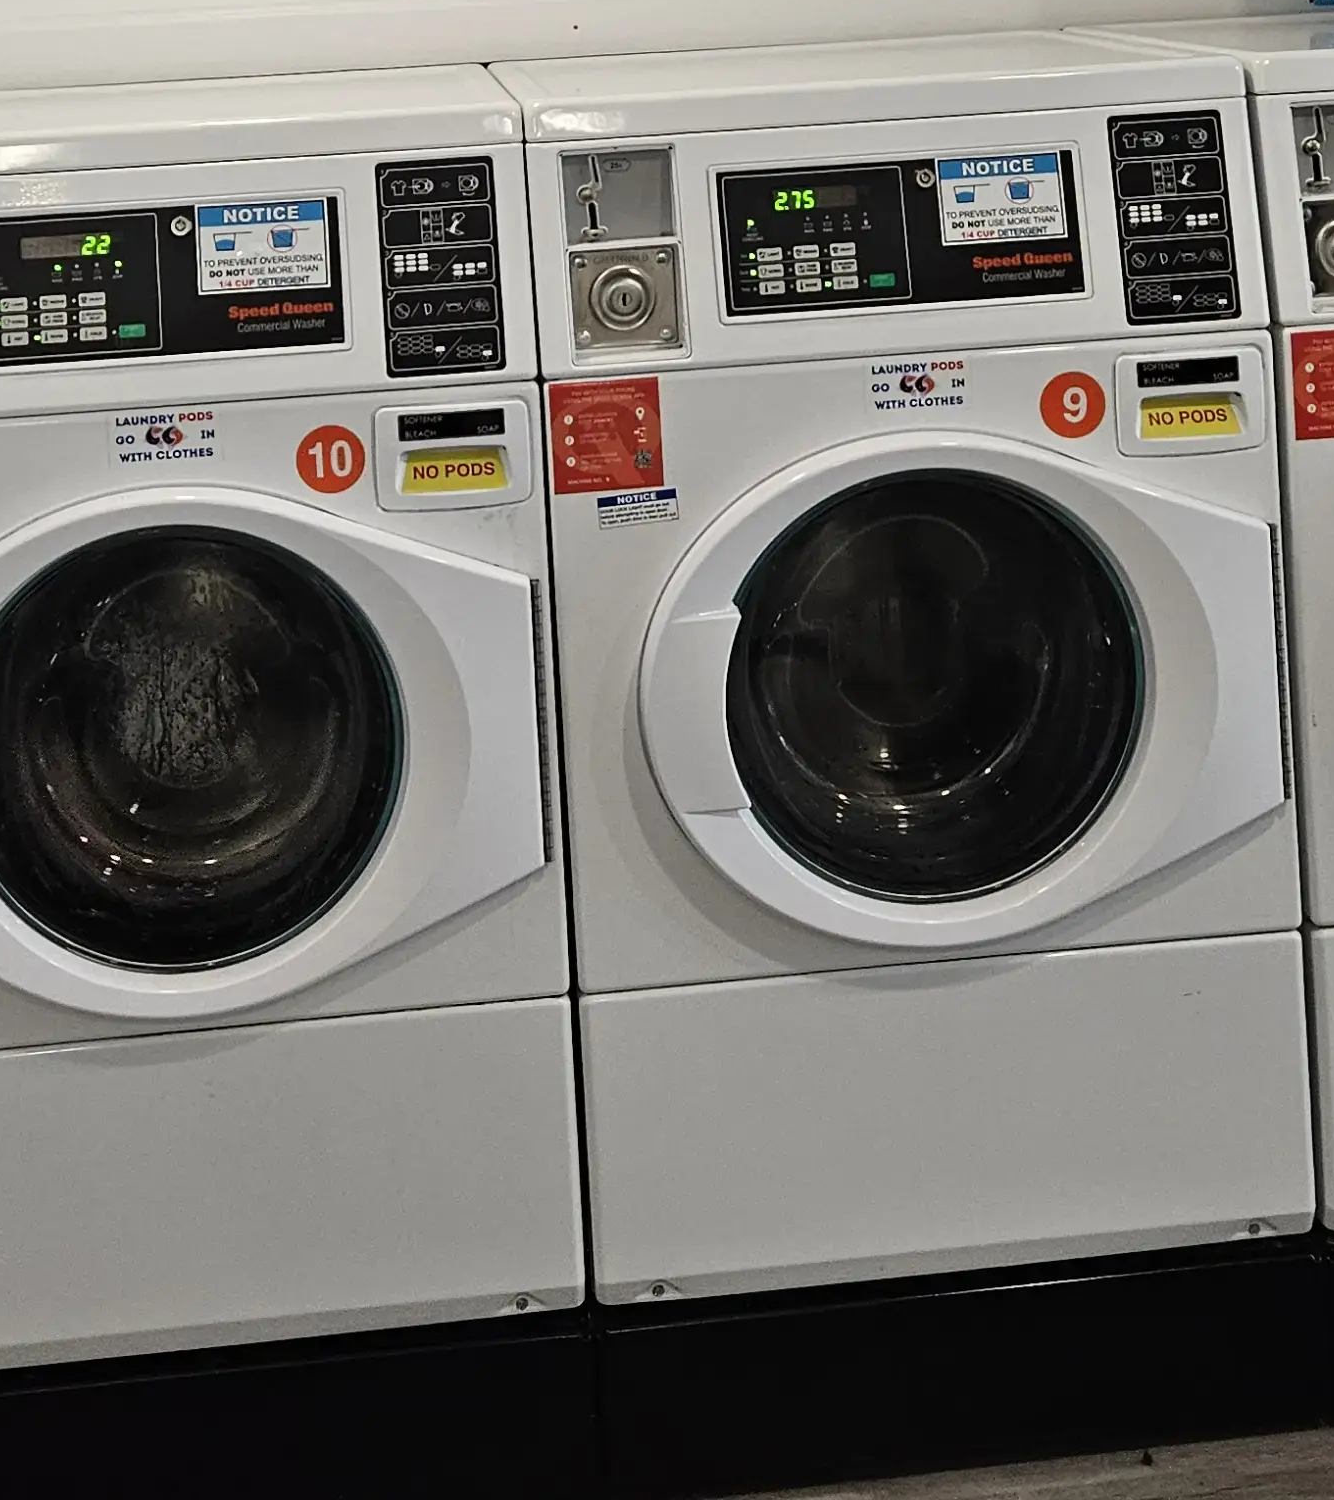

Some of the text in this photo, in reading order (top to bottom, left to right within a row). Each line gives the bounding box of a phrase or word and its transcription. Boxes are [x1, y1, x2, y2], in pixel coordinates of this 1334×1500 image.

[962, 158, 1034, 176] NOTICE
[774, 190, 814, 211] 2.75
[223, 206, 299, 222] NOTICE
[959, 209, 996, 218] PREVENT
[968, 220, 986, 228] NOT
[998, 226, 1047, 236] DETERGENT
[81, 235, 111, 256] 22
[218, 258, 258, 266] PREVENT
[973, 252, 1073, 270] Speed Queen
[257, 276, 310, 285] DETERGENT
[228, 302, 334, 320] Speed Queen
[872, 360, 964, 375] LAUNDRY PODS
[872, 378, 965, 392] GO IN
[875, 395, 963, 410] WITH CLOTHES
[1063, 387, 1088, 424] 9
[116, 411, 213, 427] LAUNDRY PODS
[1149, 408, 1228, 425] NO PODS
[116, 429, 214, 445] GO IN
[119, 447, 213, 463] WITH CLOTHES
[309, 440, 352, 478] 10
[413, 462, 495, 479] NO PODS
[617, 492, 657, 504] NOTICE
